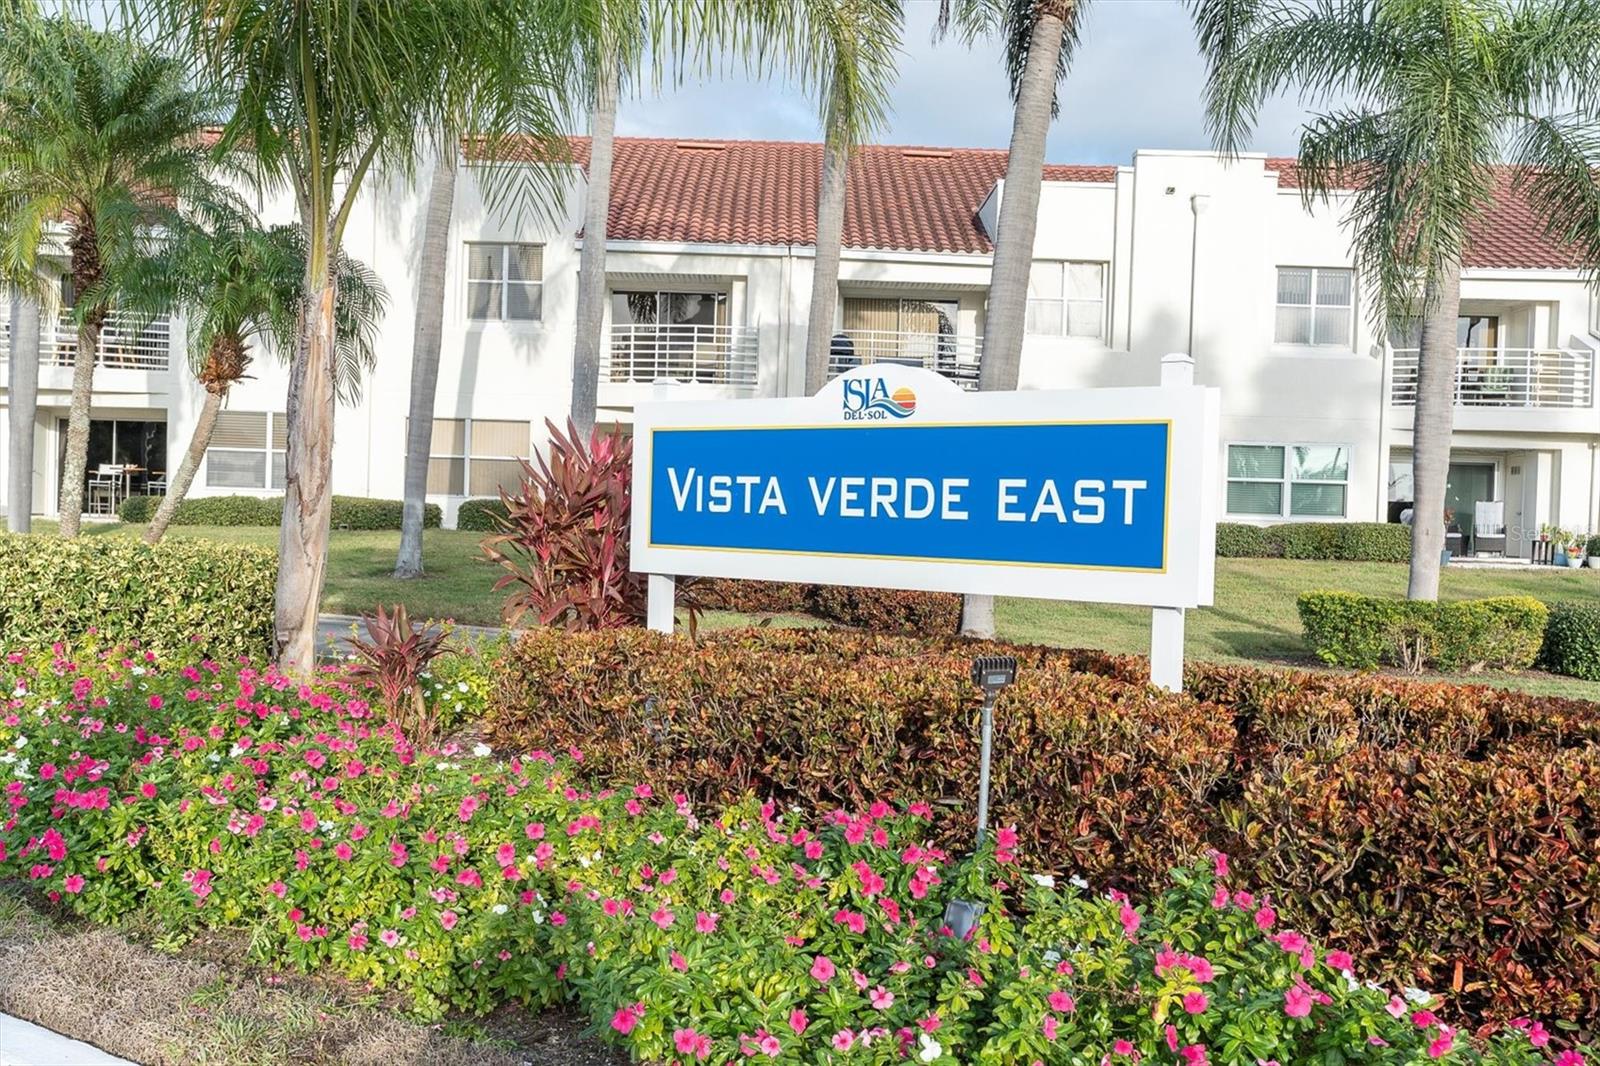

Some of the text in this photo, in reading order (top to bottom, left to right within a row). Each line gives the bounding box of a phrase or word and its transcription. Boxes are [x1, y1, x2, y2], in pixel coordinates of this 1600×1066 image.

[843, 378, 890, 411] ISLA
[667, 467, 1148, 525] VISTA VERDE EAST
